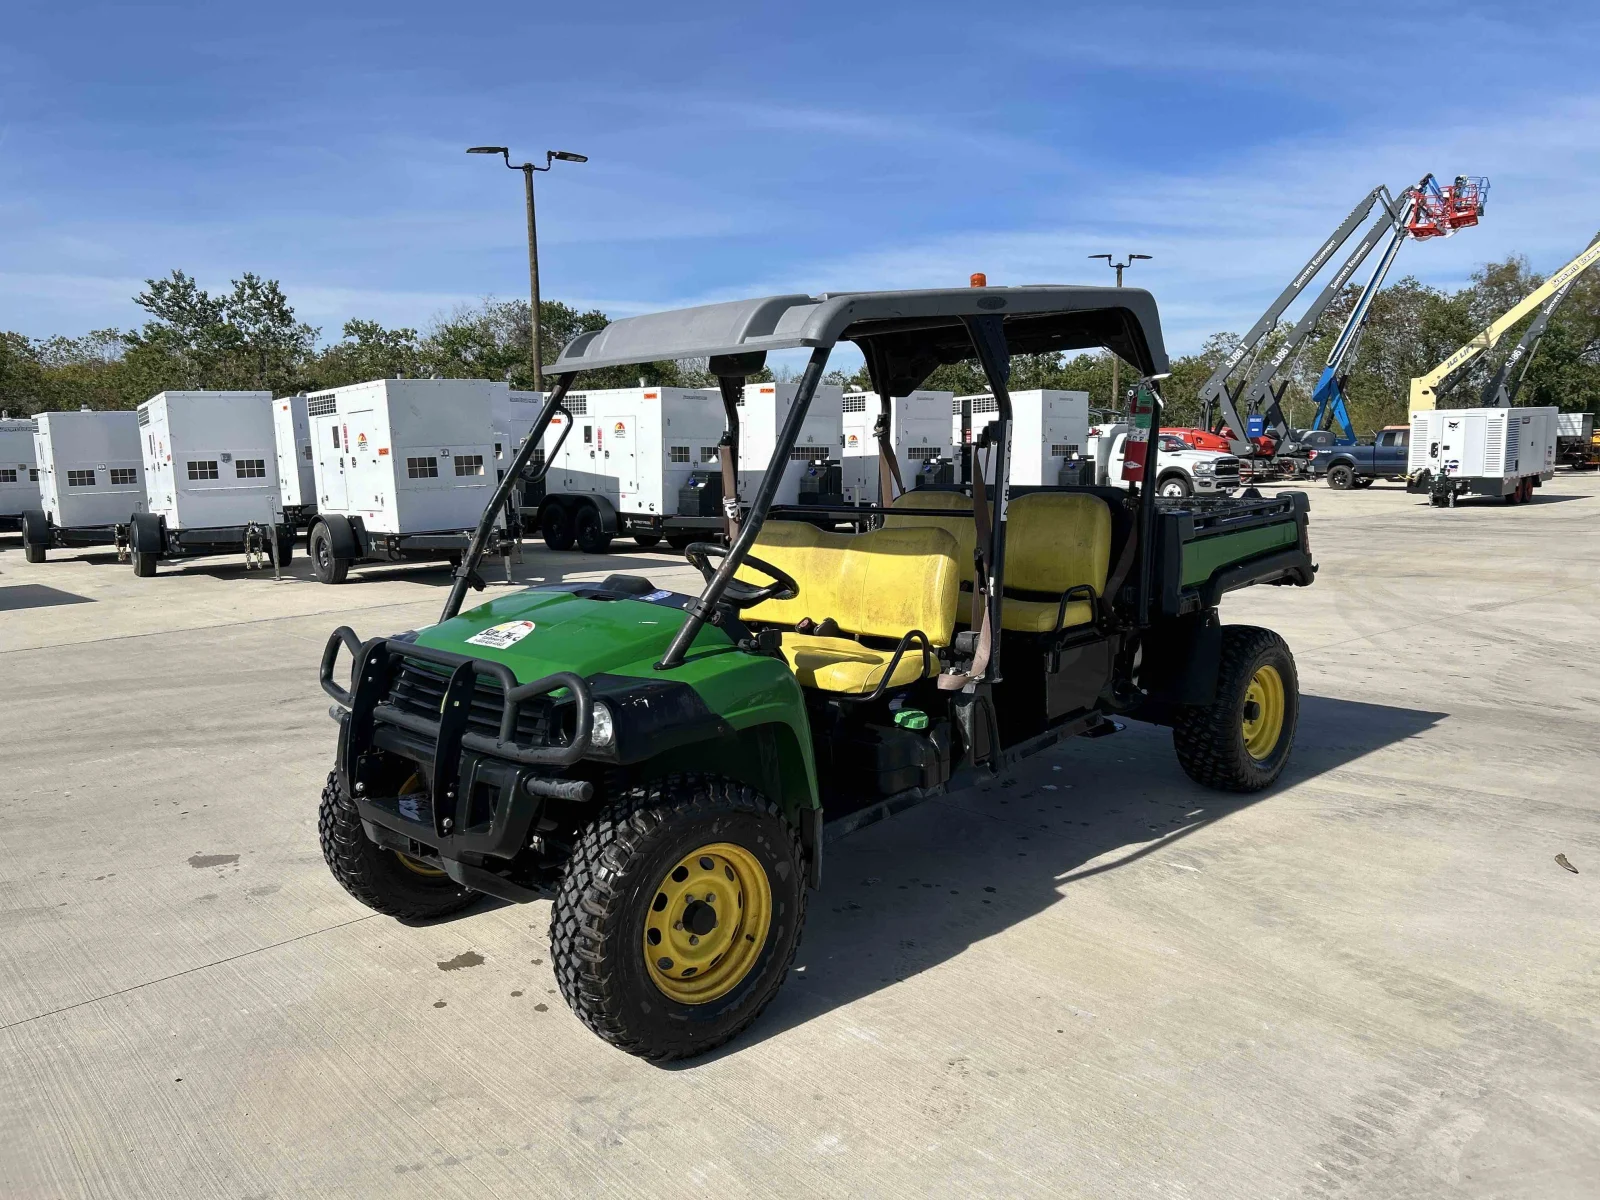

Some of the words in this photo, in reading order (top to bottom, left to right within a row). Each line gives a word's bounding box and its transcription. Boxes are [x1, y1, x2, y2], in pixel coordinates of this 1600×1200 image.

[1271, 347, 1290, 367] SJ86
[1446, 357, 1459, 369] JLG
[1460, 345, 1475, 362] LIFT
[1505, 352, 1521, 369] SJ86
